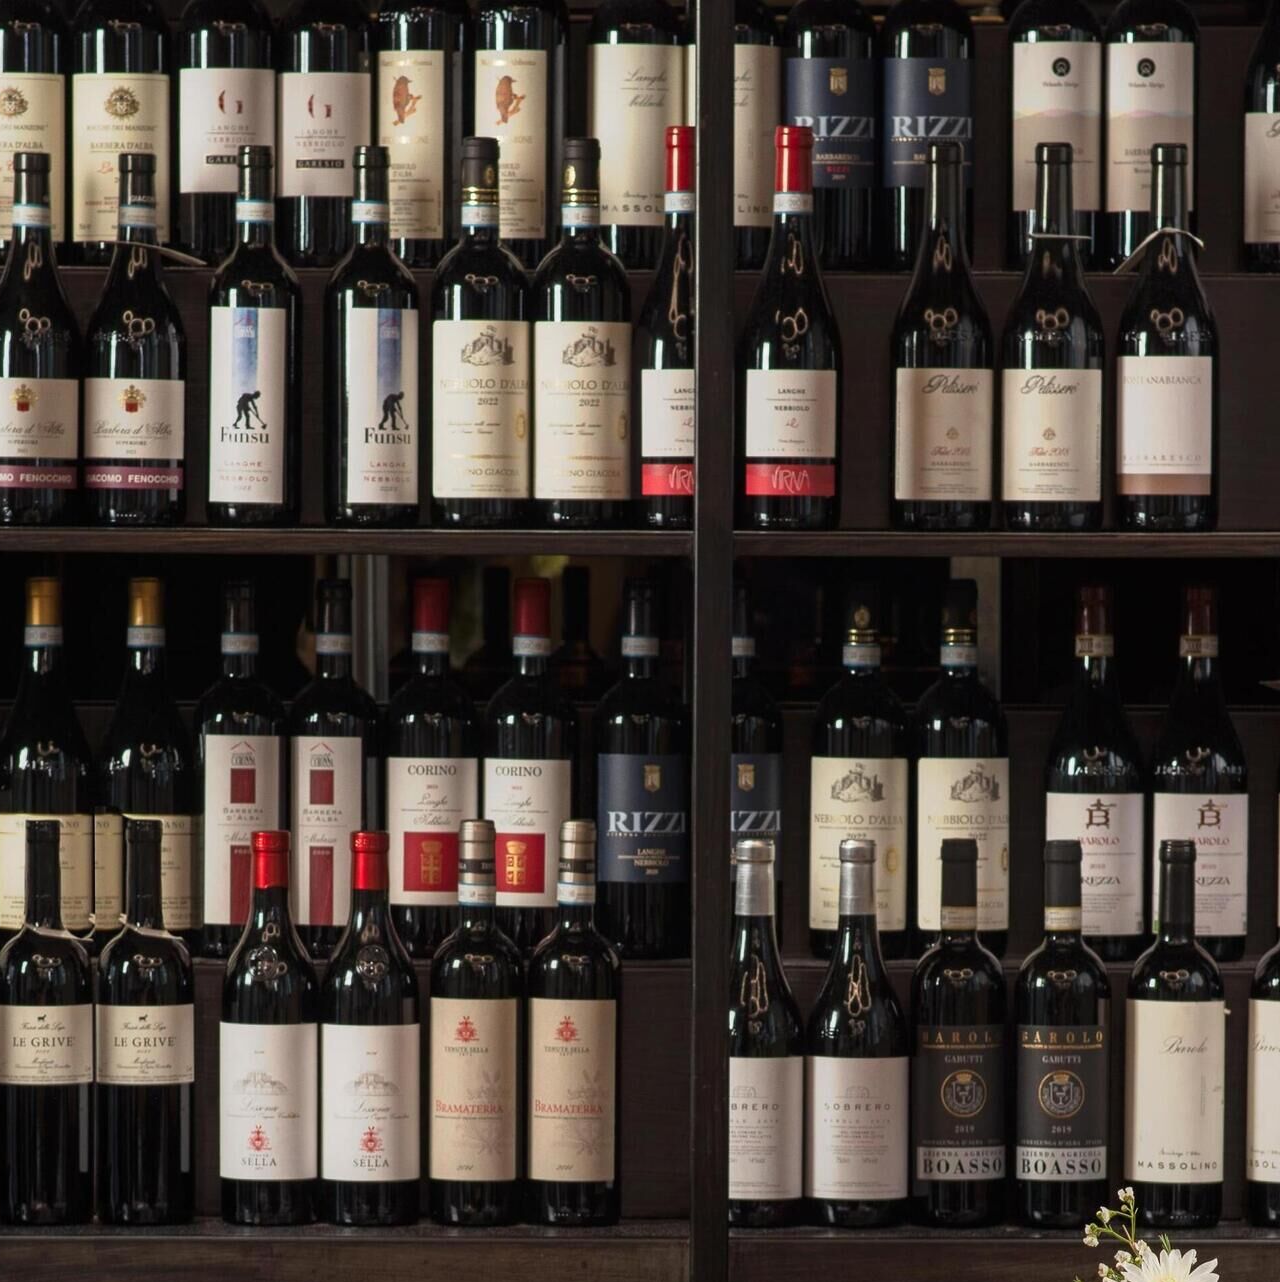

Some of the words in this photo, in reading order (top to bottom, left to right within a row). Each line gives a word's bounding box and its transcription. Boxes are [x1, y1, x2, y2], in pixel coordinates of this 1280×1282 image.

[893, 116, 973, 138] RIZZI
[297, 160, 343, 168] GARESIO
[601, 204, 662, 213] MASSOL
[477, 397, 499, 407] 2022
[579, 399, 600, 408] 2022
[19, 473, 73, 484] FENOCCHIO
[127, 474, 179, 484] FENOCCHIO
[407, 765, 457, 776] CORINO
[495, 766, 543, 777] CORINO
[607, 811, 685, 832] RIZZI
[1081, 876, 1121, 885] REZZA
[1195, 876, 1231, 885] REZZA
[12, 1037, 27, 1047] LE
[114, 1037, 128, 1047] LE
[435, 1100, 504, 1114] BRAMATERRA
[534, 1100, 603, 1114] BRAMATERRA
[731, 1103, 780, 1111] BRERO
[241, 1157, 277, 1167] SELLA
[352, 1159, 390, 1168] SELLA
[922, 1158, 1002, 1174] BOASSO
[1021, 1157, 1102, 1174] BOASSO
[1138, 1161, 1218, 1170] MASSOLINO
